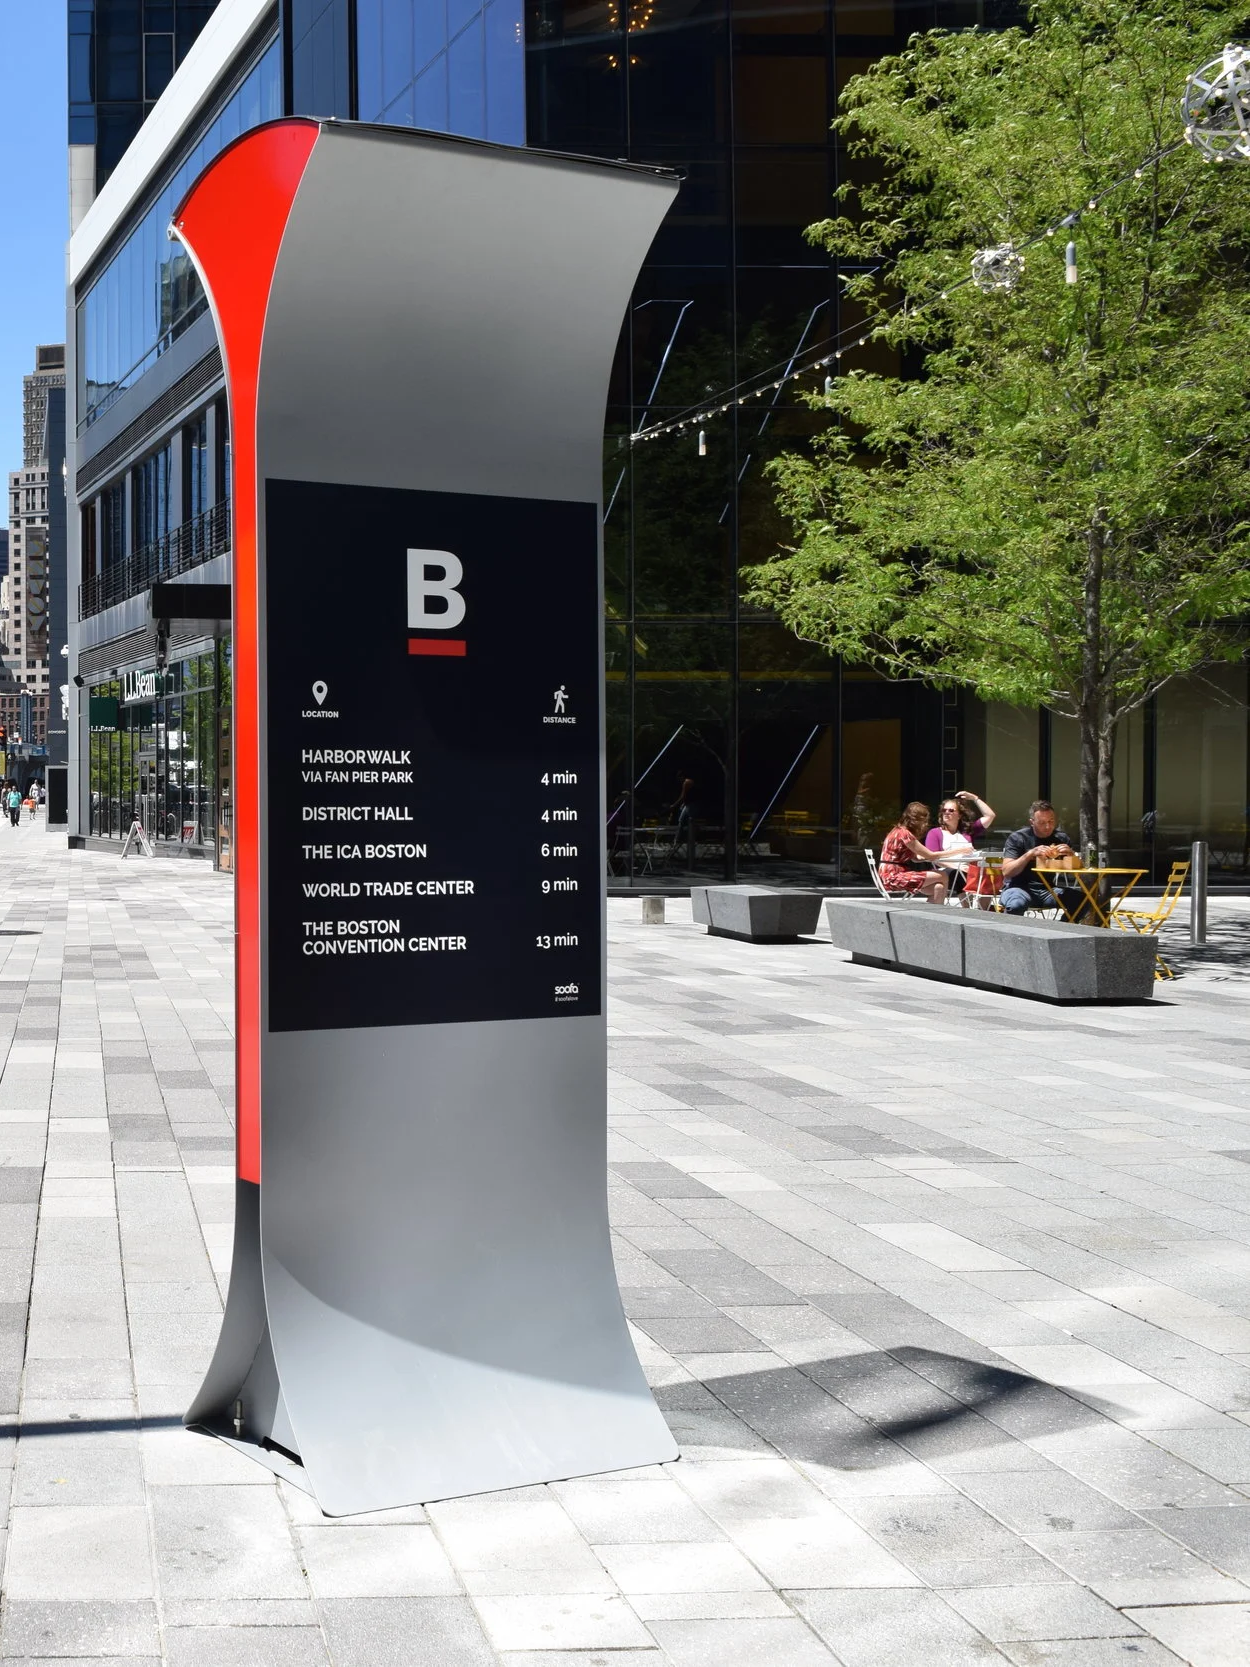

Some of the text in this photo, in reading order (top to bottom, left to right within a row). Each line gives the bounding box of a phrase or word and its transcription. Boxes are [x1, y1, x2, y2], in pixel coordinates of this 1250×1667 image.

[407, 548, 466, 629] B
[124, 670, 156, 701] L.L.Bean
[303, 750, 411, 764] HARBORWALK
[302, 771, 413, 783] VIA FAN PIER PARK
[541, 771, 577, 785] 4 min
[303, 807, 413, 820] DISTRICT HALL
[542, 807, 577, 822] 4 min
[302, 844, 426, 859] THE ICA BOSTON
[541, 843, 577, 856] 6 min
[303, 881, 474, 897] WORLD TRADE CENTER
[542, 877, 577, 893] 9 min
[303, 920, 399, 935] THE BOSTON
[303, 936, 466, 955] CONVENTION CENTER
[536, 933, 578, 949] 13 min
[555, 983, 578, 994] soofa
